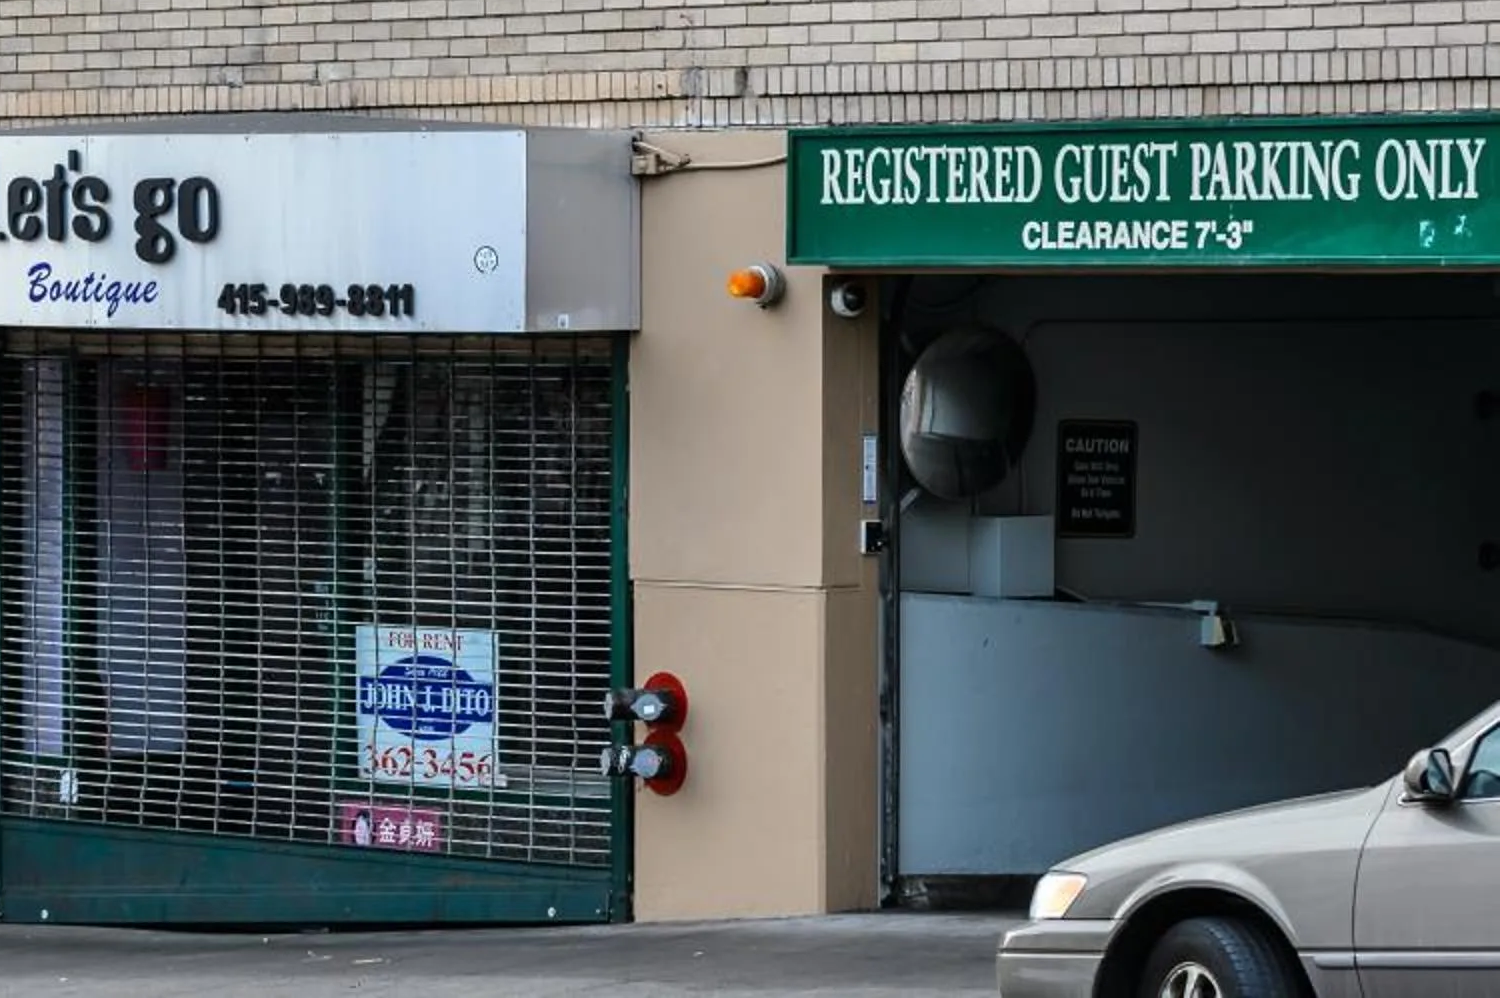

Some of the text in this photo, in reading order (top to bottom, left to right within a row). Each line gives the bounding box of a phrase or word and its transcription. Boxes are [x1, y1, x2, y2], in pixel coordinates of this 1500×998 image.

[820, 137, 1487, 204] REGISTERED GUEST PARKING ONLY
[133, 176, 221, 264] go
[1022, 220, 1254, 250] CLEARANCE 7'-3"
[27, 261, 159, 318] Boutique
[1065, 438, 1129, 454] CAUTION
[388, 632, 464, 651] FOR RENT
[363, 682, 417, 711] JOHN
[440, 687, 490, 717] DITO
[363, 744, 493, 783] 362-3456
